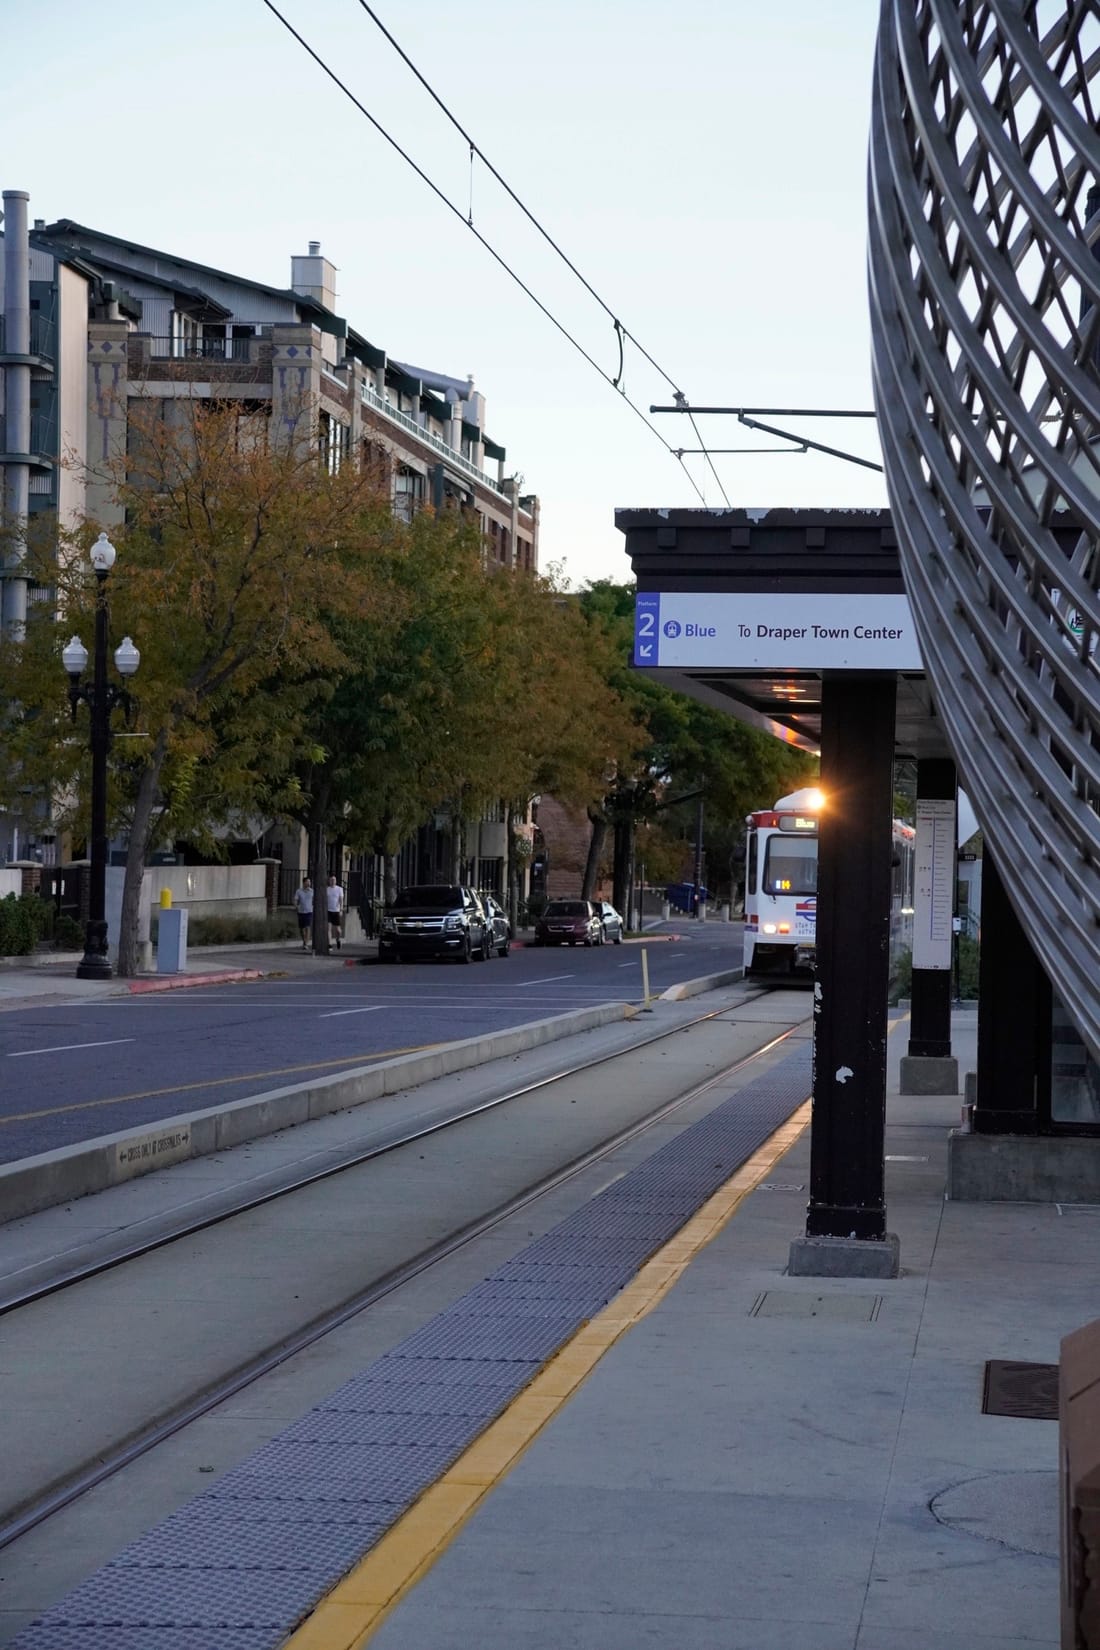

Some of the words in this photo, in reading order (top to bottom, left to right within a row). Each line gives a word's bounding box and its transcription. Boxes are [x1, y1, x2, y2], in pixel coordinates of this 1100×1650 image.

[638, 613, 655, 636] 2
[685, 624, 717, 638] Blue
[738, 624, 751, 638] To
[756, 625, 807, 640] Draper
[811, 626, 850, 639] Town
[853, 626, 904, 640] Center
